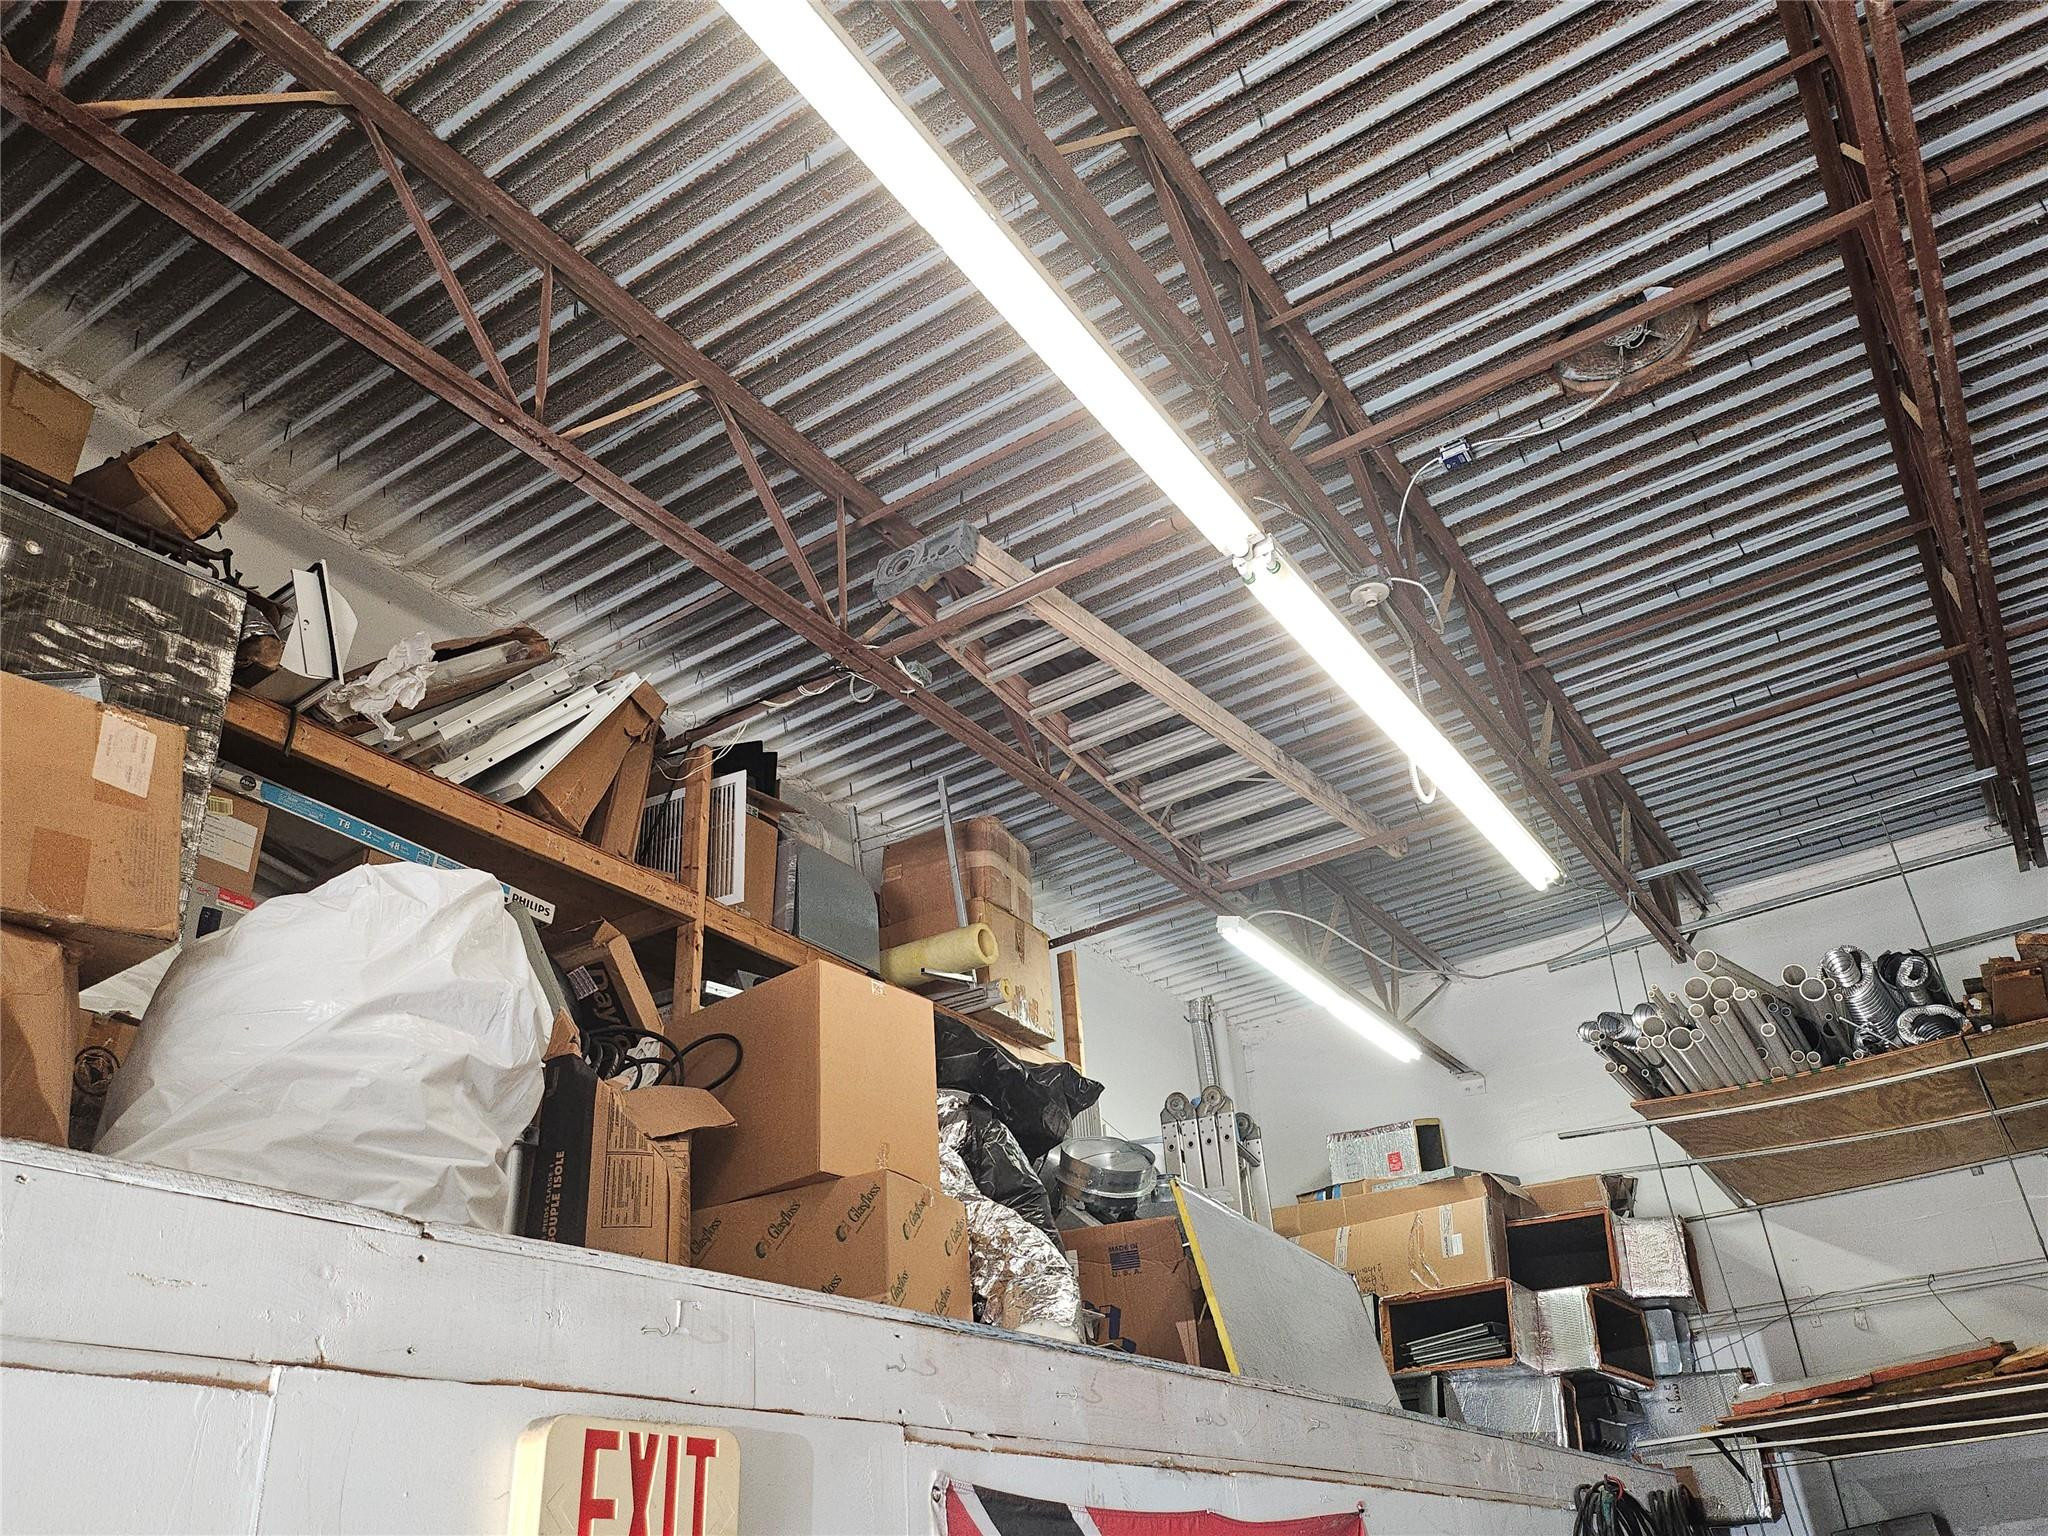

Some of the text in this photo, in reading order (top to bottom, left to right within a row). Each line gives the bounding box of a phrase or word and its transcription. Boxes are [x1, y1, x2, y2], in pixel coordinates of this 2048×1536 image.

[338, 817, 351, 829] T8
[360, 828, 373, 839] 32
[388, 841, 401, 851] 48
[511, 893, 551, 917] PHILIPS
[553, 1151, 565, 1188] ISOLE
[767, 1201, 801, 1240] Glasfloss
[848, 1184, 881, 1223] Glasfloss
[577, 1428, 719, 1536] EXIT
